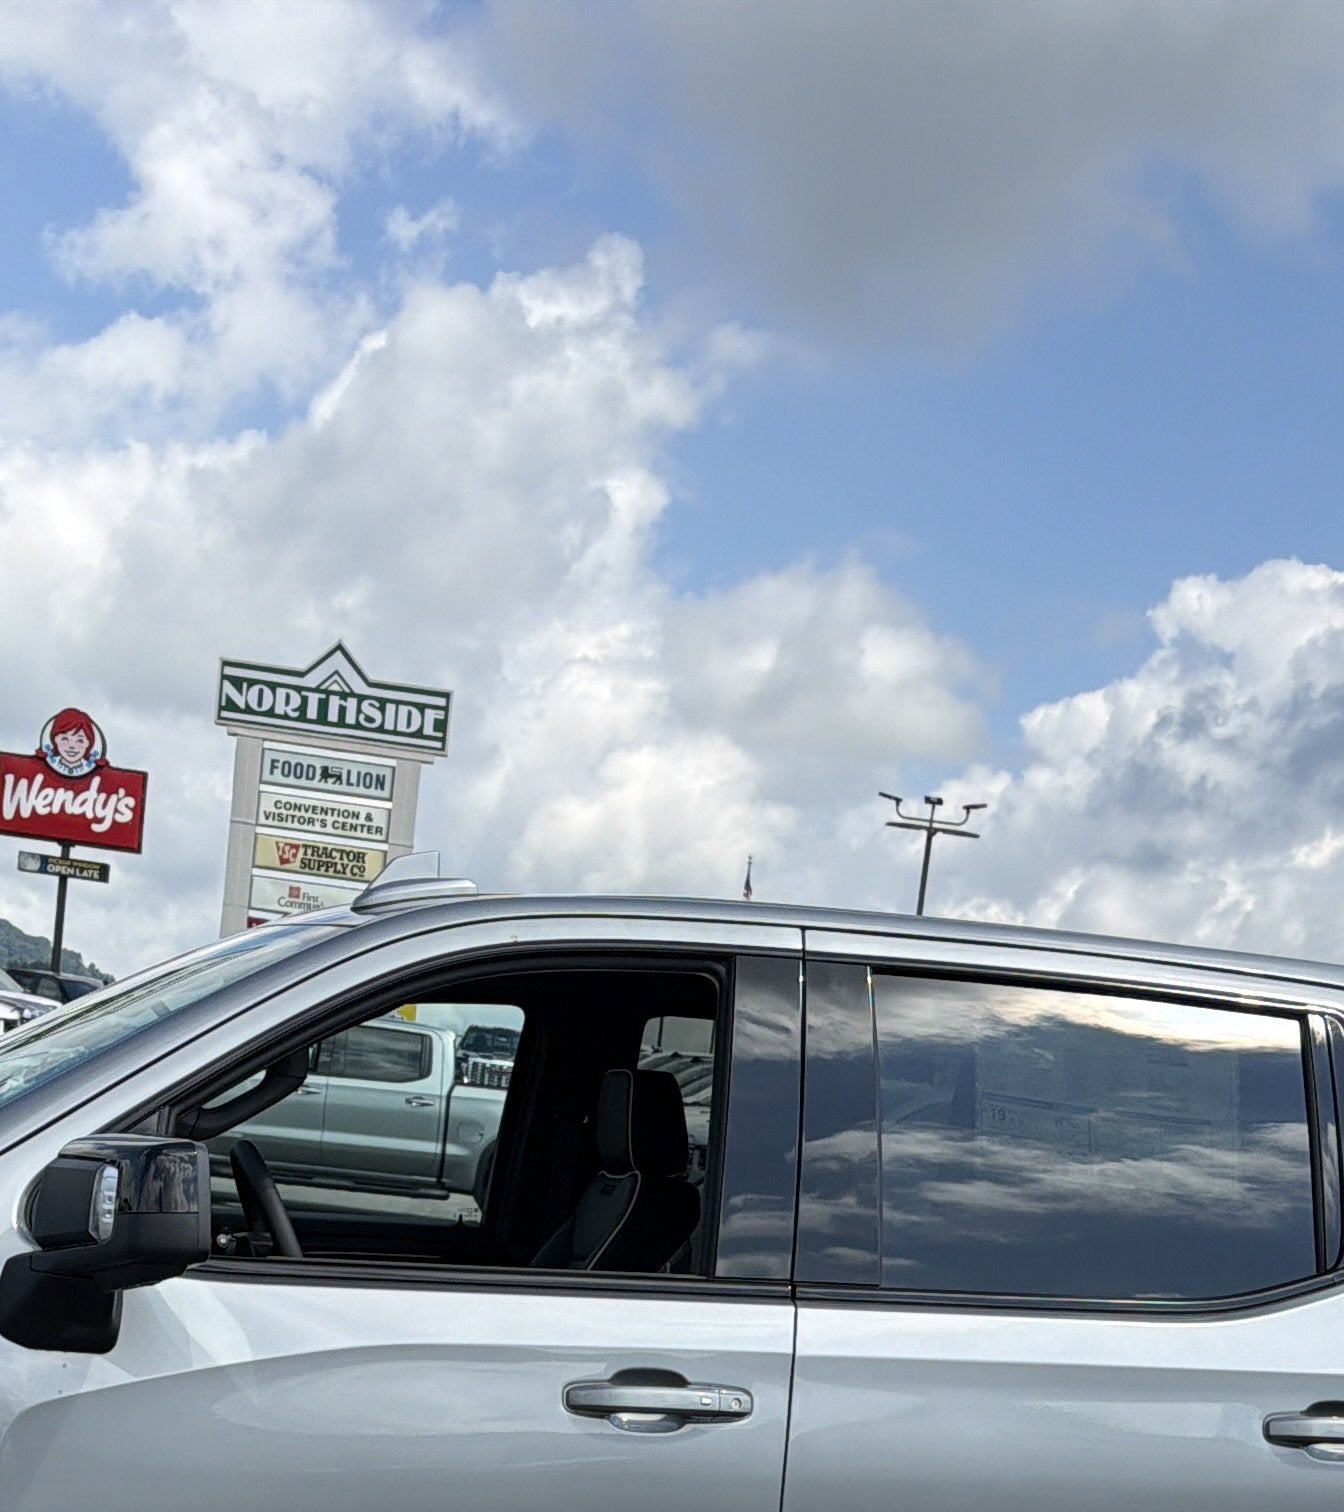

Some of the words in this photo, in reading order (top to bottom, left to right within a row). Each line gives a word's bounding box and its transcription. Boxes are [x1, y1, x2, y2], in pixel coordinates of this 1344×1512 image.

[220, 679, 445, 738] NORTHSIDE
[269, 758, 316, 782] FOOD
[345, 769, 386, 792] LION
[2, 773, 136, 833] Wendy's
[273, 799, 360, 821] CONVENTION
[364, 812, 374, 823] &
[263, 809, 328, 829] VISITOR'S
[331, 820, 384, 836] CENTER
[278, 841, 297, 863] TSC
[300, 843, 368, 865] TRACTOR
[46, 864, 74, 875] OPEN
[76, 867, 100, 879] LATE
[299, 857, 349, 875] SUPPLY
